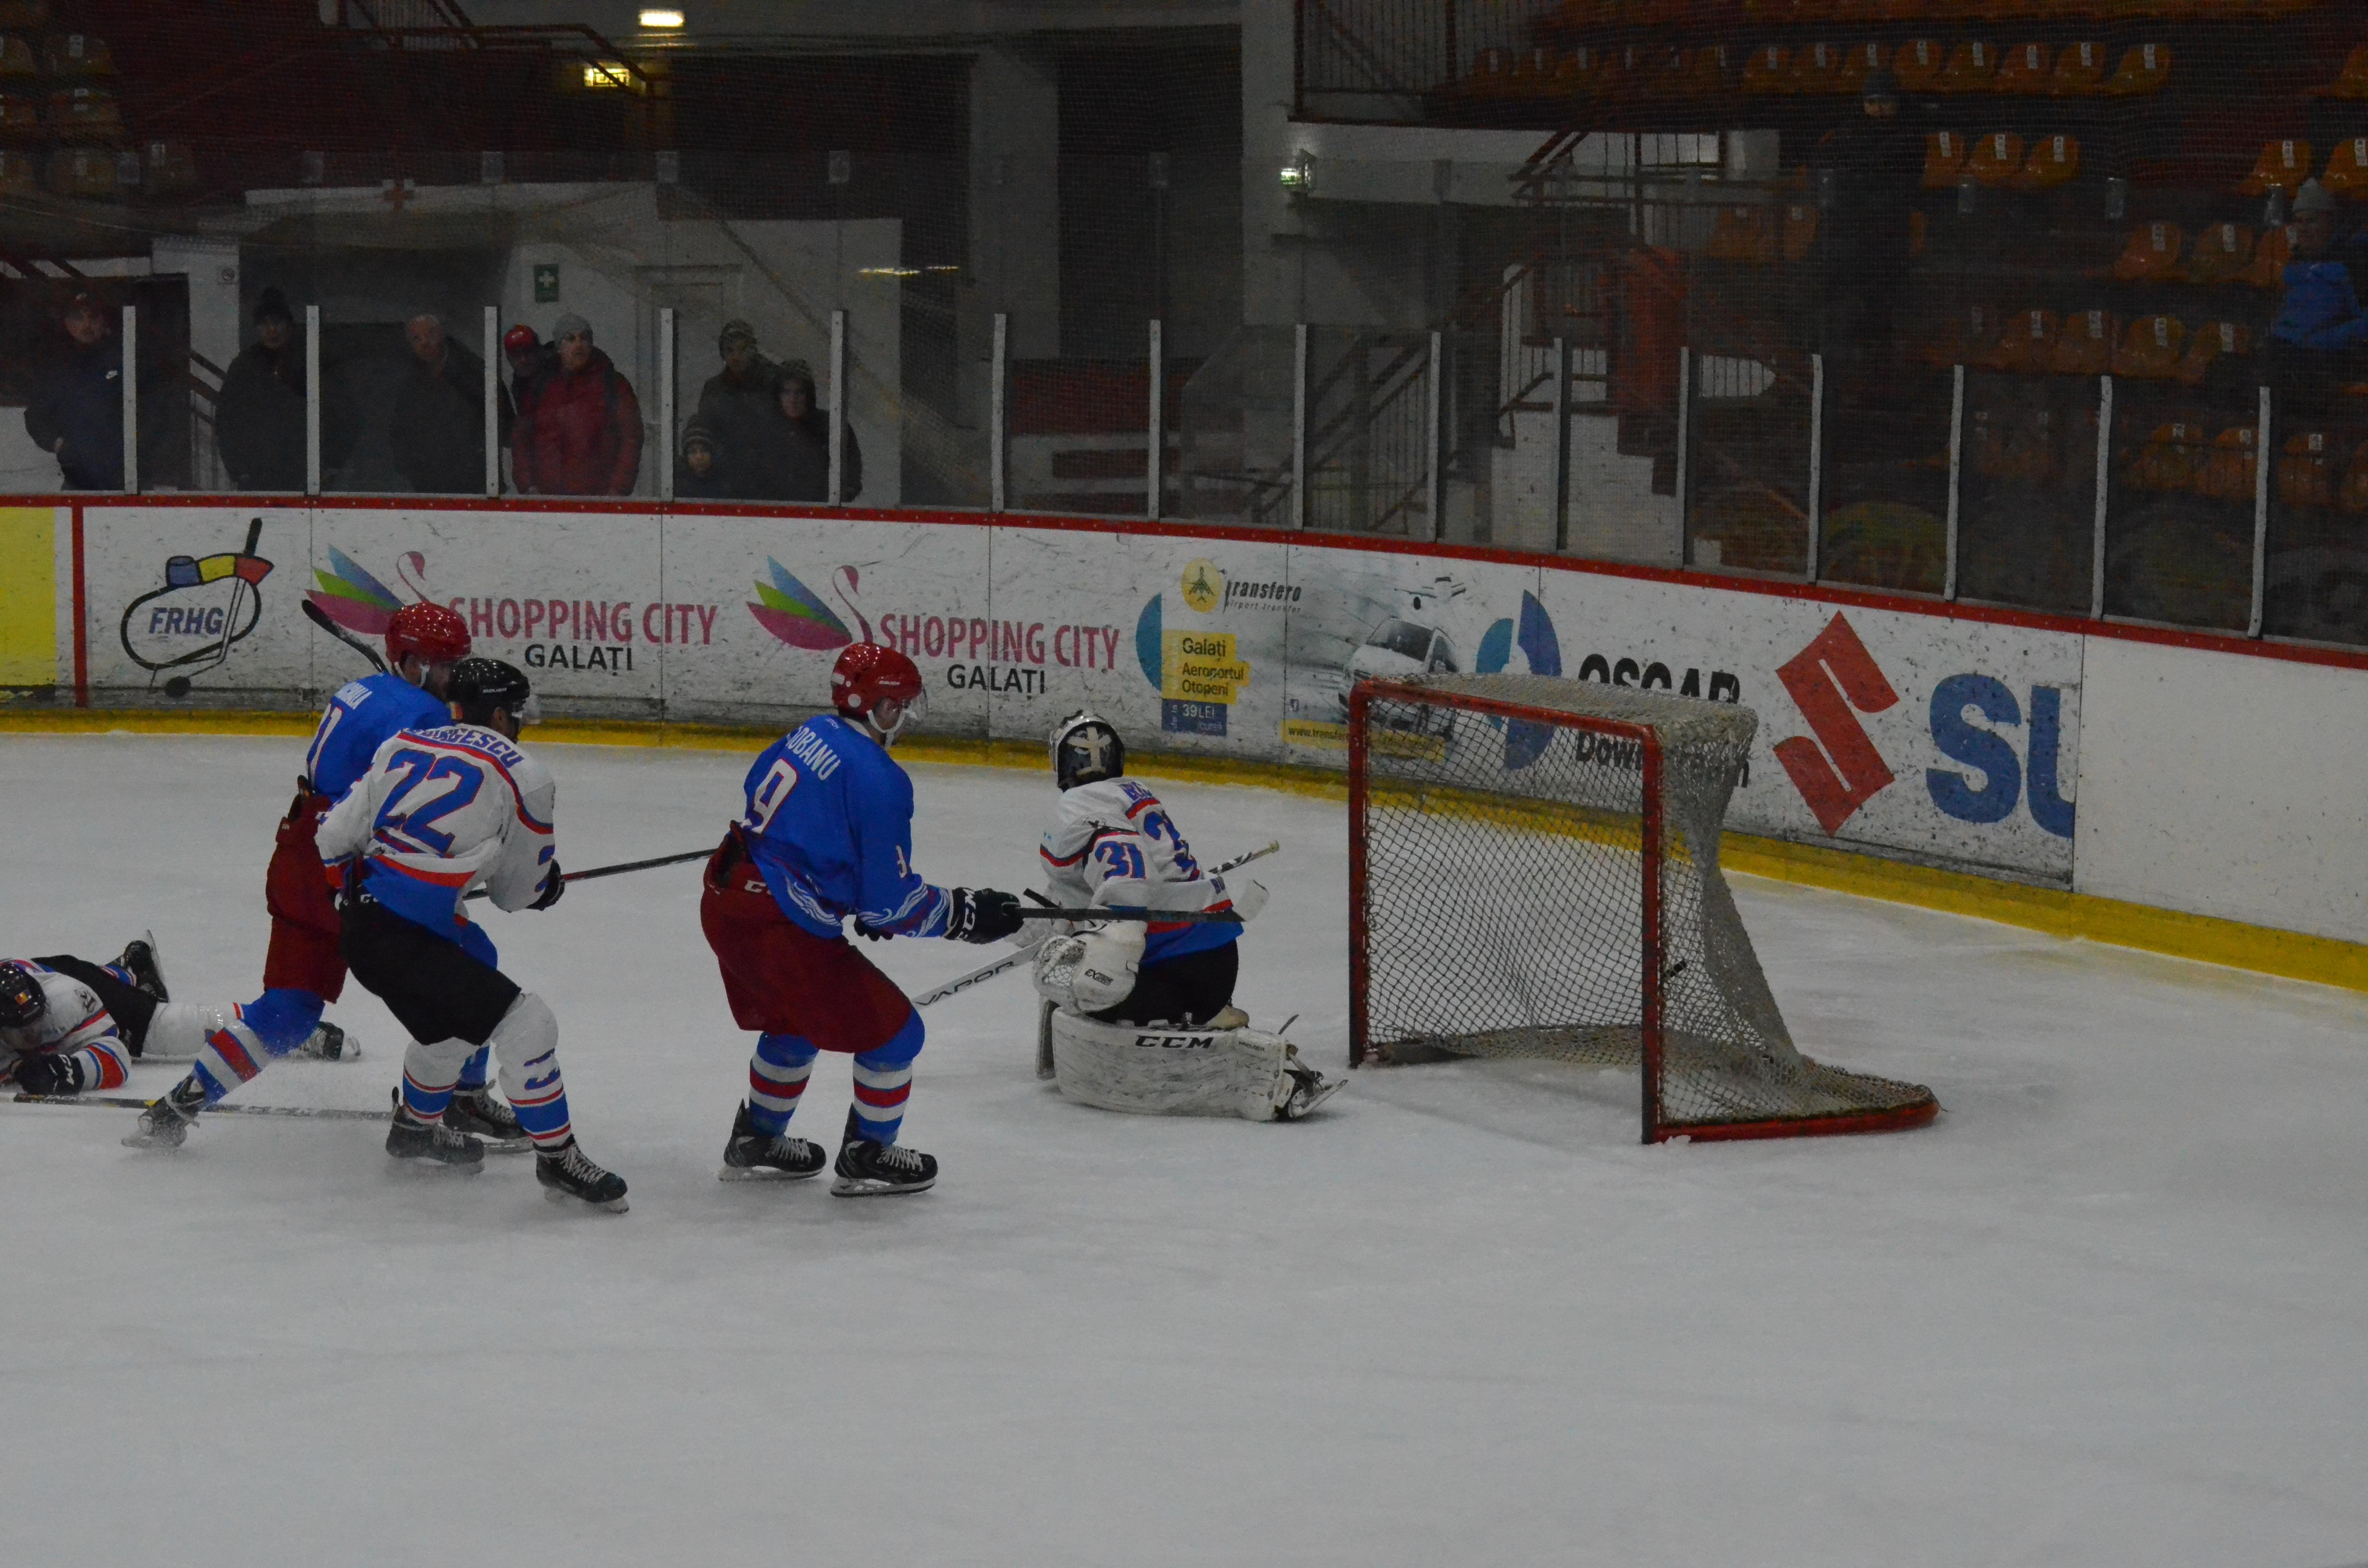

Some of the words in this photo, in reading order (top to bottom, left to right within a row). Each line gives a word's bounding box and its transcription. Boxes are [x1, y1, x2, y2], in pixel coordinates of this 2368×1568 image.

[148, 607, 224, 635] FRHG
[642, 603, 717, 645] CITY
[880, 613, 1045, 664] SHOPPING
[1054, 624, 1120, 670] CITY
[1183, 637, 1225, 662] Galați
[1182, 662, 1244, 680] Aeroportul
[1182, 679, 1228, 697] Otopeni
[372, 748, 485, 853] 22
[1095, 840, 1147, 881] 31
[1135, 1035, 1214, 1048] CCM
